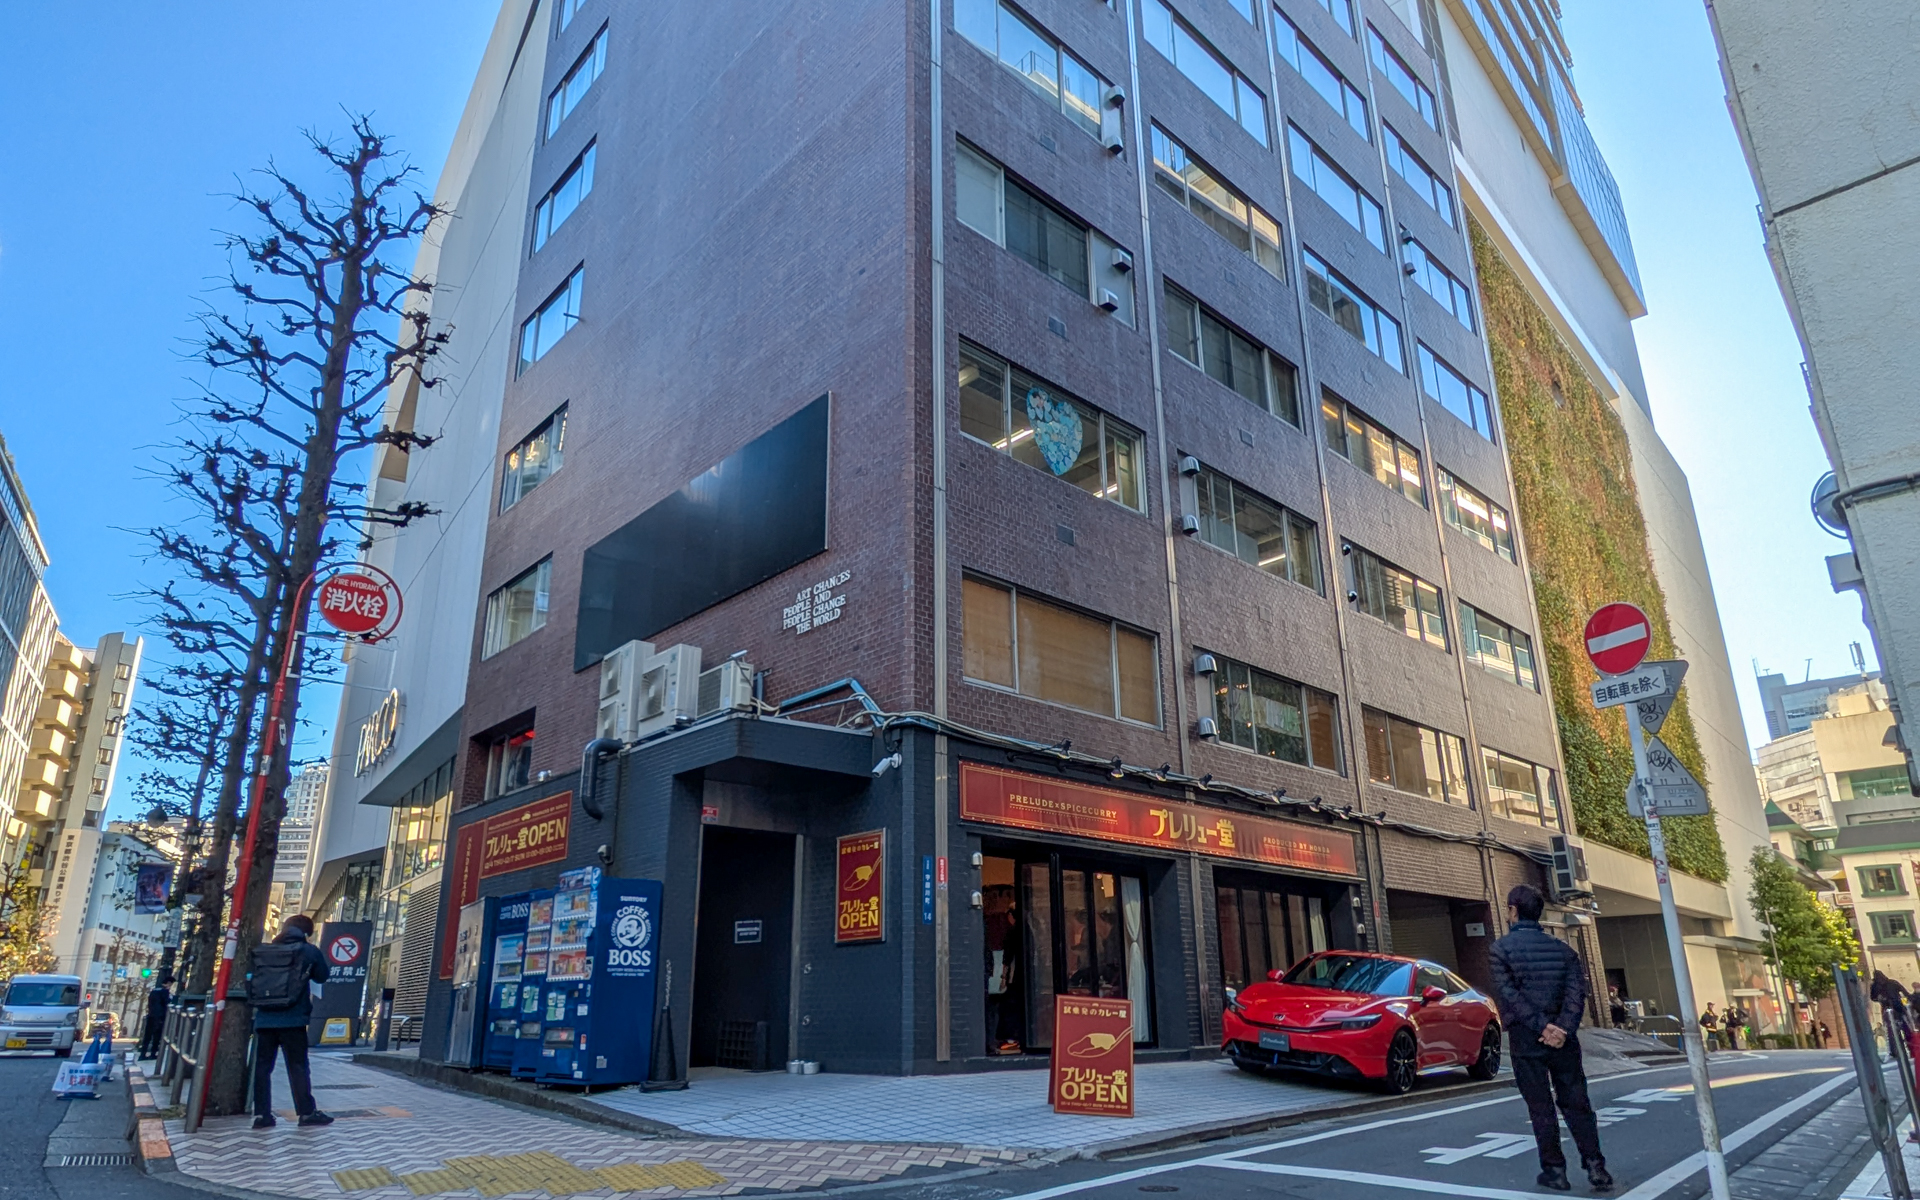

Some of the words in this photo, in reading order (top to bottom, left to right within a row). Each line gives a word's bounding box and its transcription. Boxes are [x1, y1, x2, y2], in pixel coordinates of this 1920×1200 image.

[333, 577, 350, 587] FIRE
[350, 580, 380, 592] HYDRANT
[796, 587, 811, 603] ART
[813, 569, 851, 594] CHANGES
[324, 586, 384, 619] 消火栓
[783, 599, 811, 618] PEOPLE
[813, 590, 831, 606] AND
[783, 609, 811, 630] PEOPLE
[813, 594, 846, 617] CHANGE
[796, 620, 811, 635] THE
[813, 608, 841, 628] WORLD
[1595, 676, 1661, 704] 自転車を除く
[1149, 808, 1236, 848] プレリュー堂
[1263, 837, 1297, 848] PRODUCED
[1309, 845, 1330, 854] HONDA
[511, 902, 530, 919] BOSS
[616, 905, 649, 920] COFFEE
[839, 896, 879, 914] プレリュー堂
[839, 910, 879, 929] OPEN
[923, 912, 932, 921] 14
[607, 949, 652, 967] BOSS
[329, 966, 366, 977] 折禁止
[1061, 1066, 1128, 1086] プレリュー堂
[1060, 1081, 1128, 1104] OPEN
